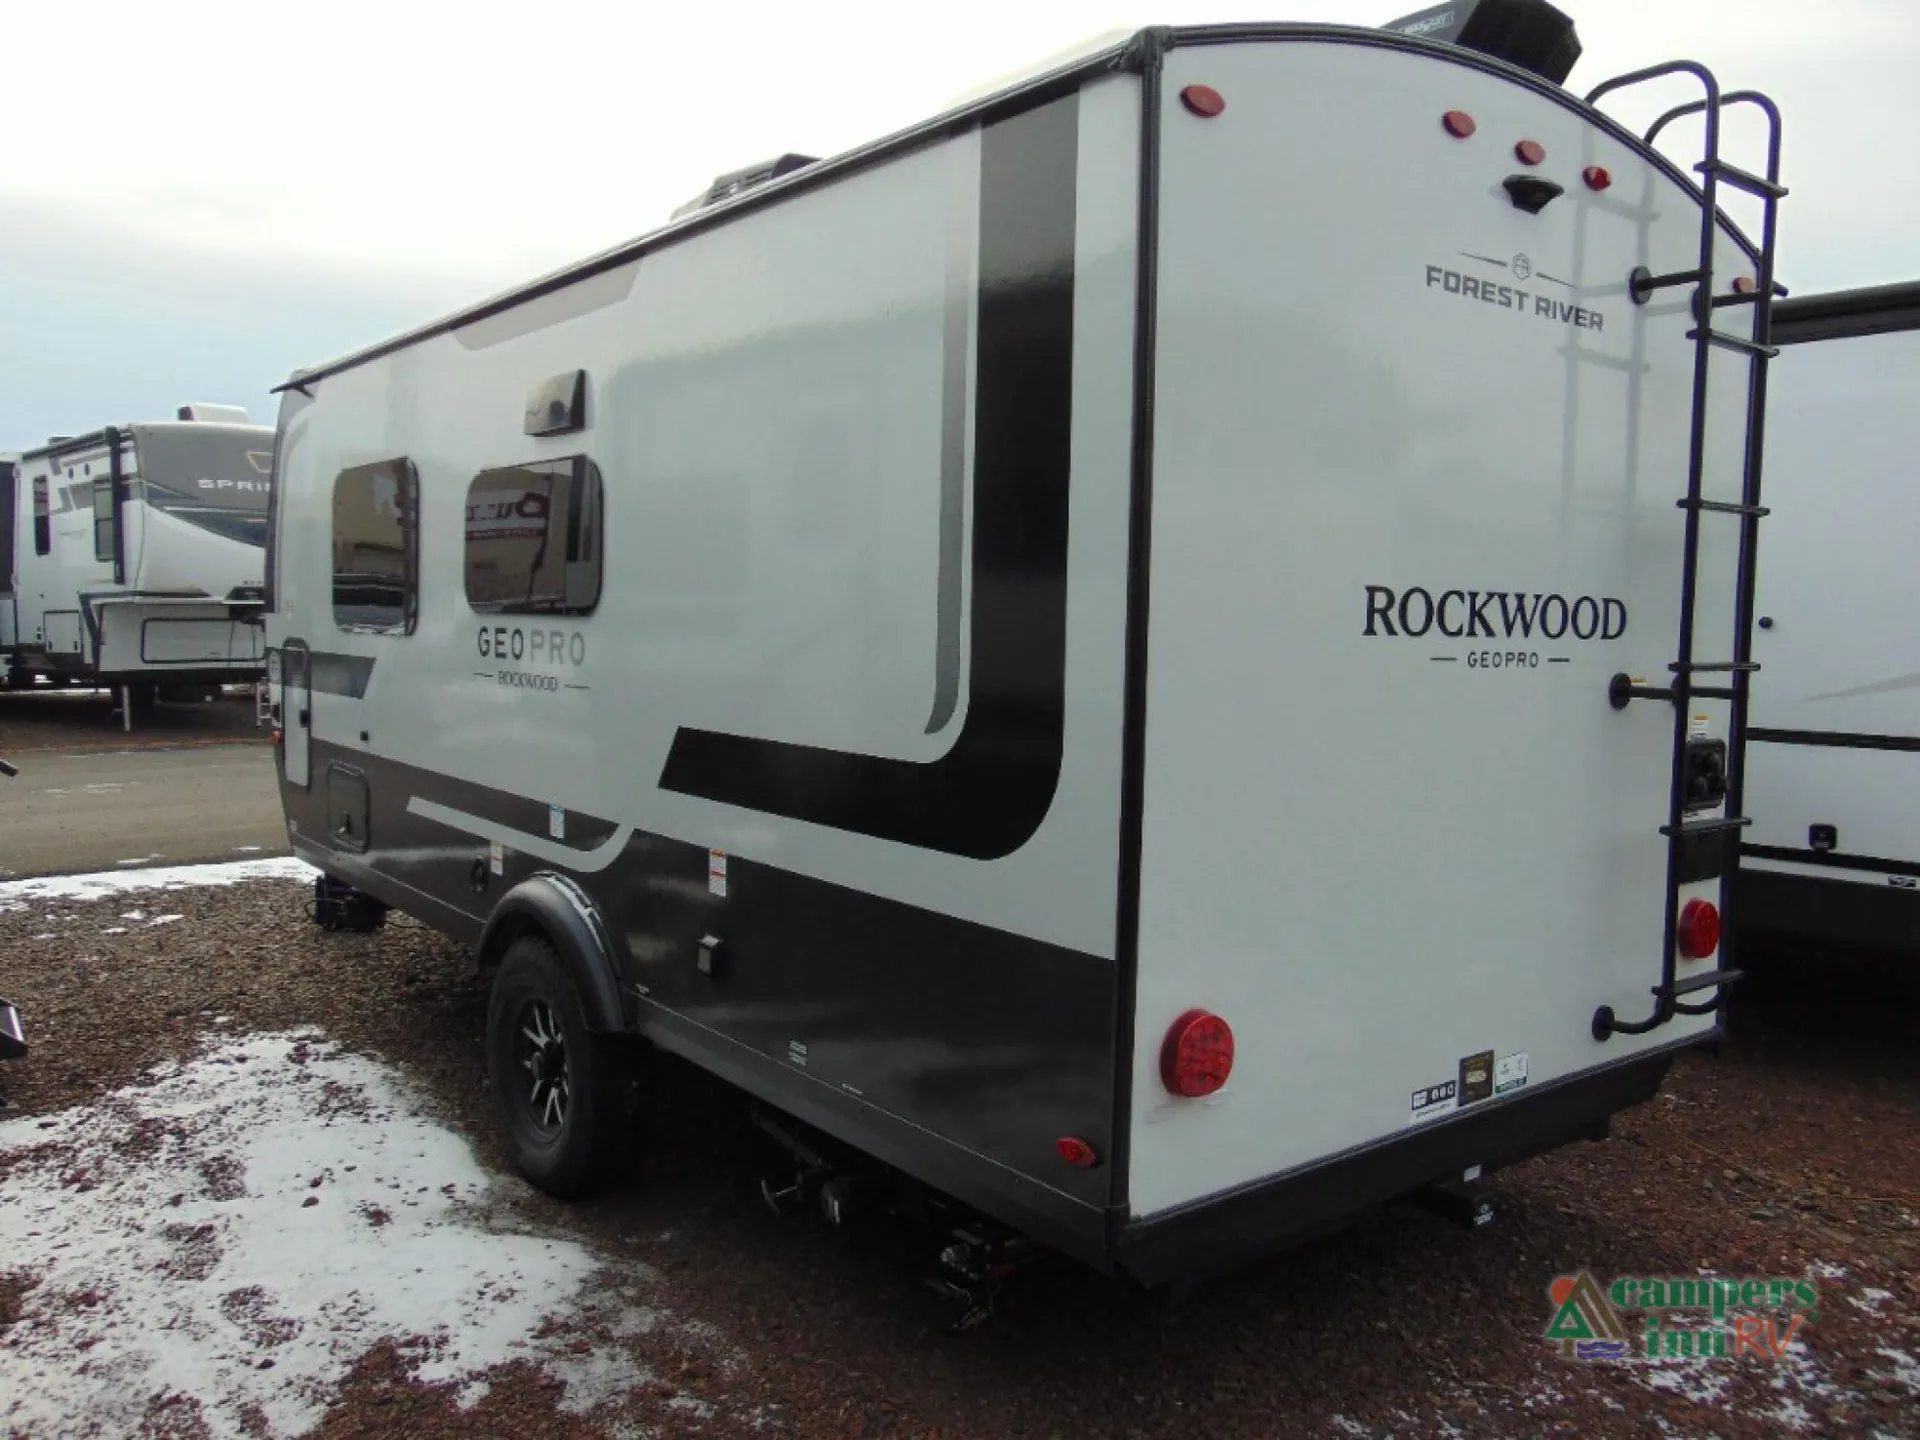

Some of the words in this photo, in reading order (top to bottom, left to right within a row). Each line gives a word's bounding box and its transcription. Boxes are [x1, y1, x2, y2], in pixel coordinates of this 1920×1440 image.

[1425, 264, 1529, 311] FOREST
[1535, 296, 1604, 332] RIVER
[1362, 585, 1627, 640] ROCKWOOD
[1467, 651, 1539, 668] GEOPRO
[498, 670, 559, 692] ROCKWOOD
